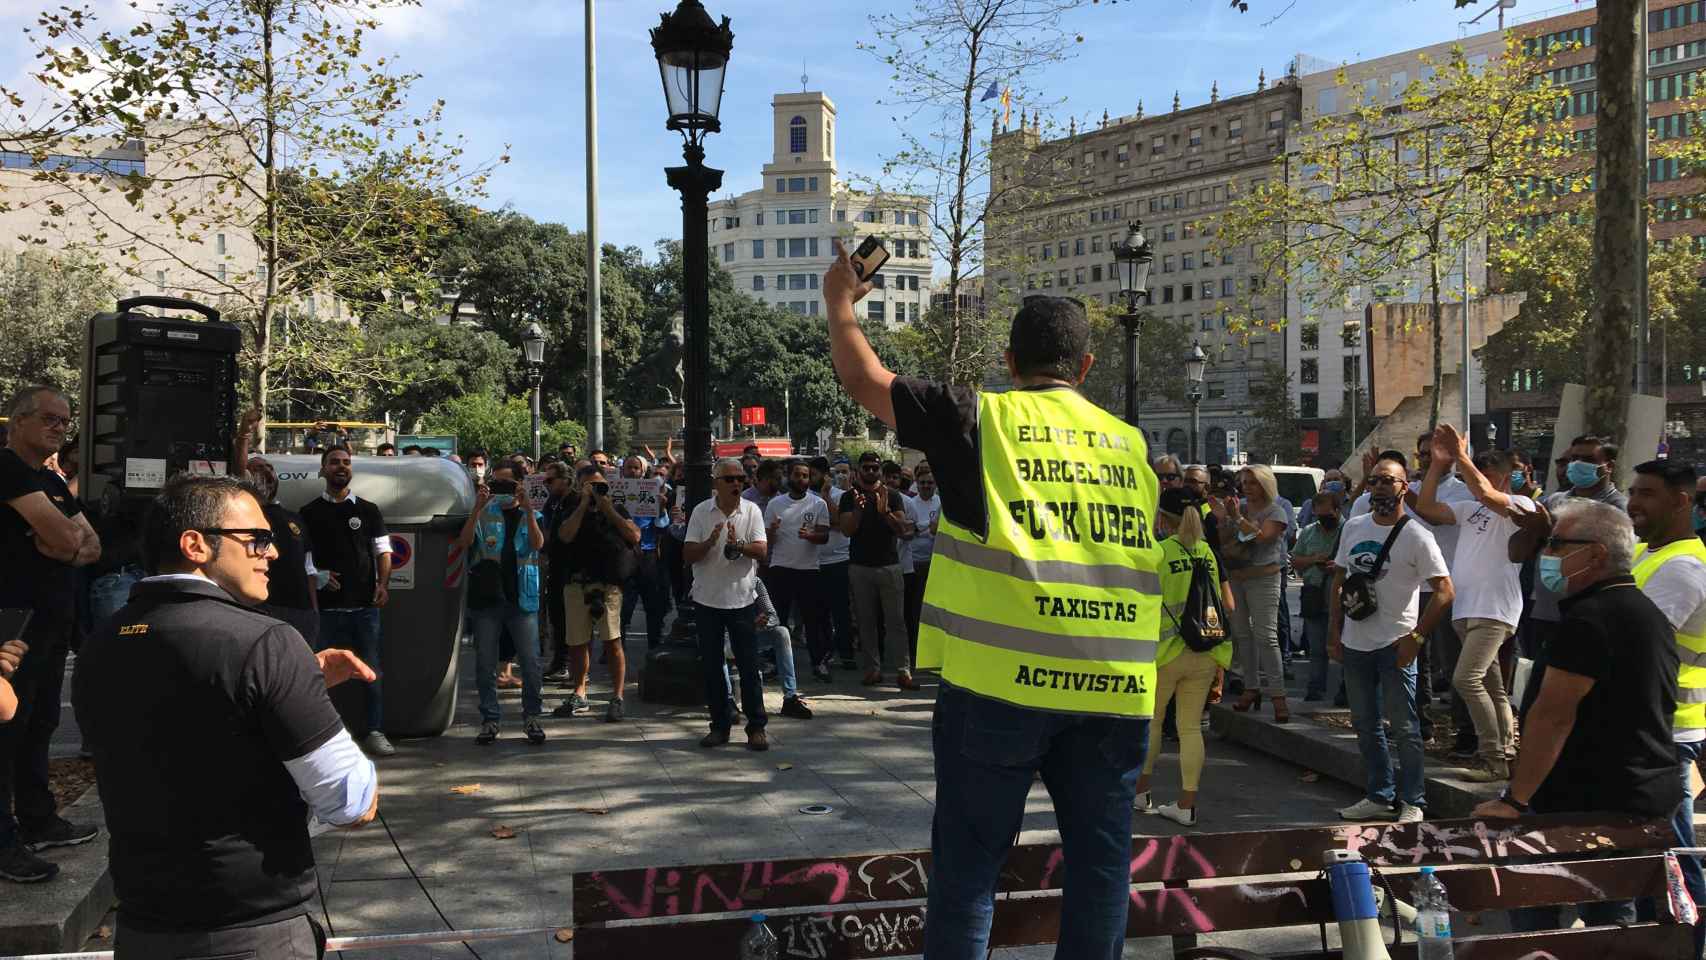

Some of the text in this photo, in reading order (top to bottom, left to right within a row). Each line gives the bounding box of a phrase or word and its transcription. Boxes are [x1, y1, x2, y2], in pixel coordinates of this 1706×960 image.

[1017, 425, 1131, 452] ELITE TAXI
[1016, 458, 1138, 490] BARCELONA
[1008, 499, 1153, 549] FUCK UBER
[1034, 595, 1137, 623] TAXISTAS
[1015, 664, 1147, 694] ACTIVISTAS
